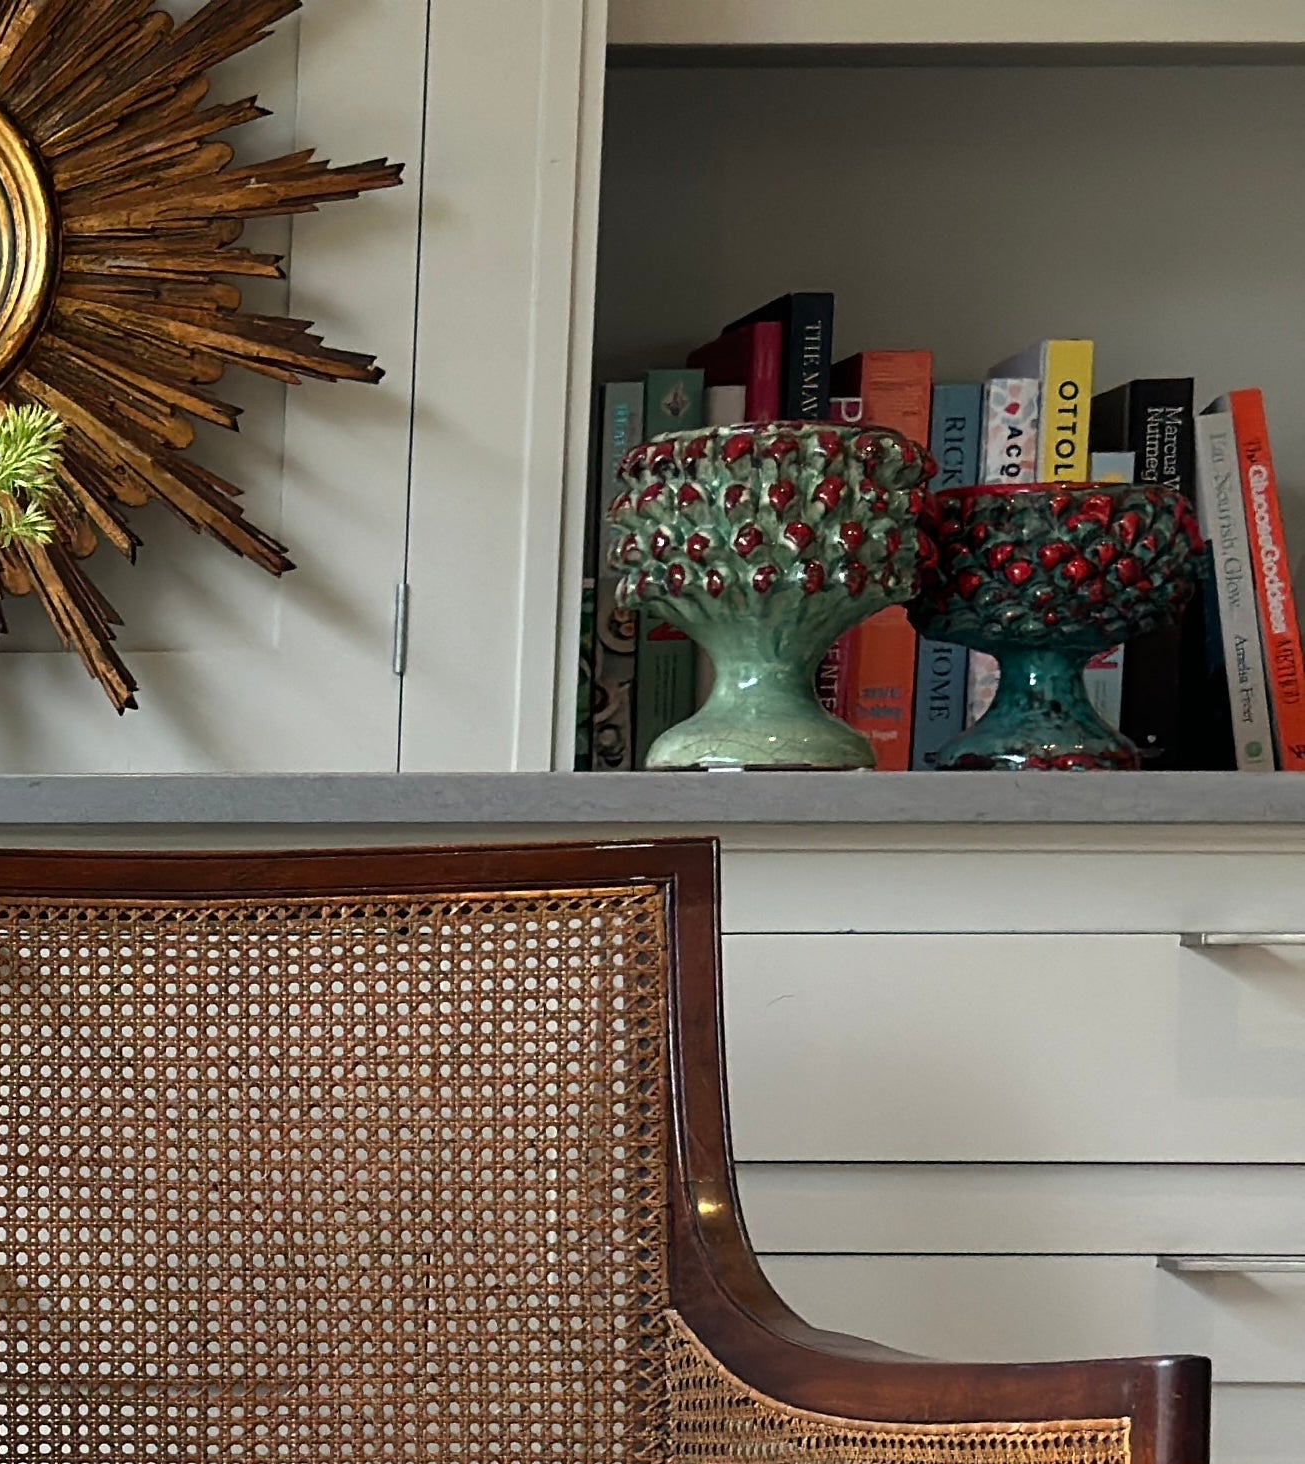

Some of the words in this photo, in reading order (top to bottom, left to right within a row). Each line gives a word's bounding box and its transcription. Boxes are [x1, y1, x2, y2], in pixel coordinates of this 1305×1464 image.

[803, 320, 822, 366] THE
[941, 416, 967, 487] RICK
[1053, 380, 1080, 483] OTTOL
[1140, 407, 1165, 483] Nutmeg
[1163, 406, 1185, 475] Marcus
